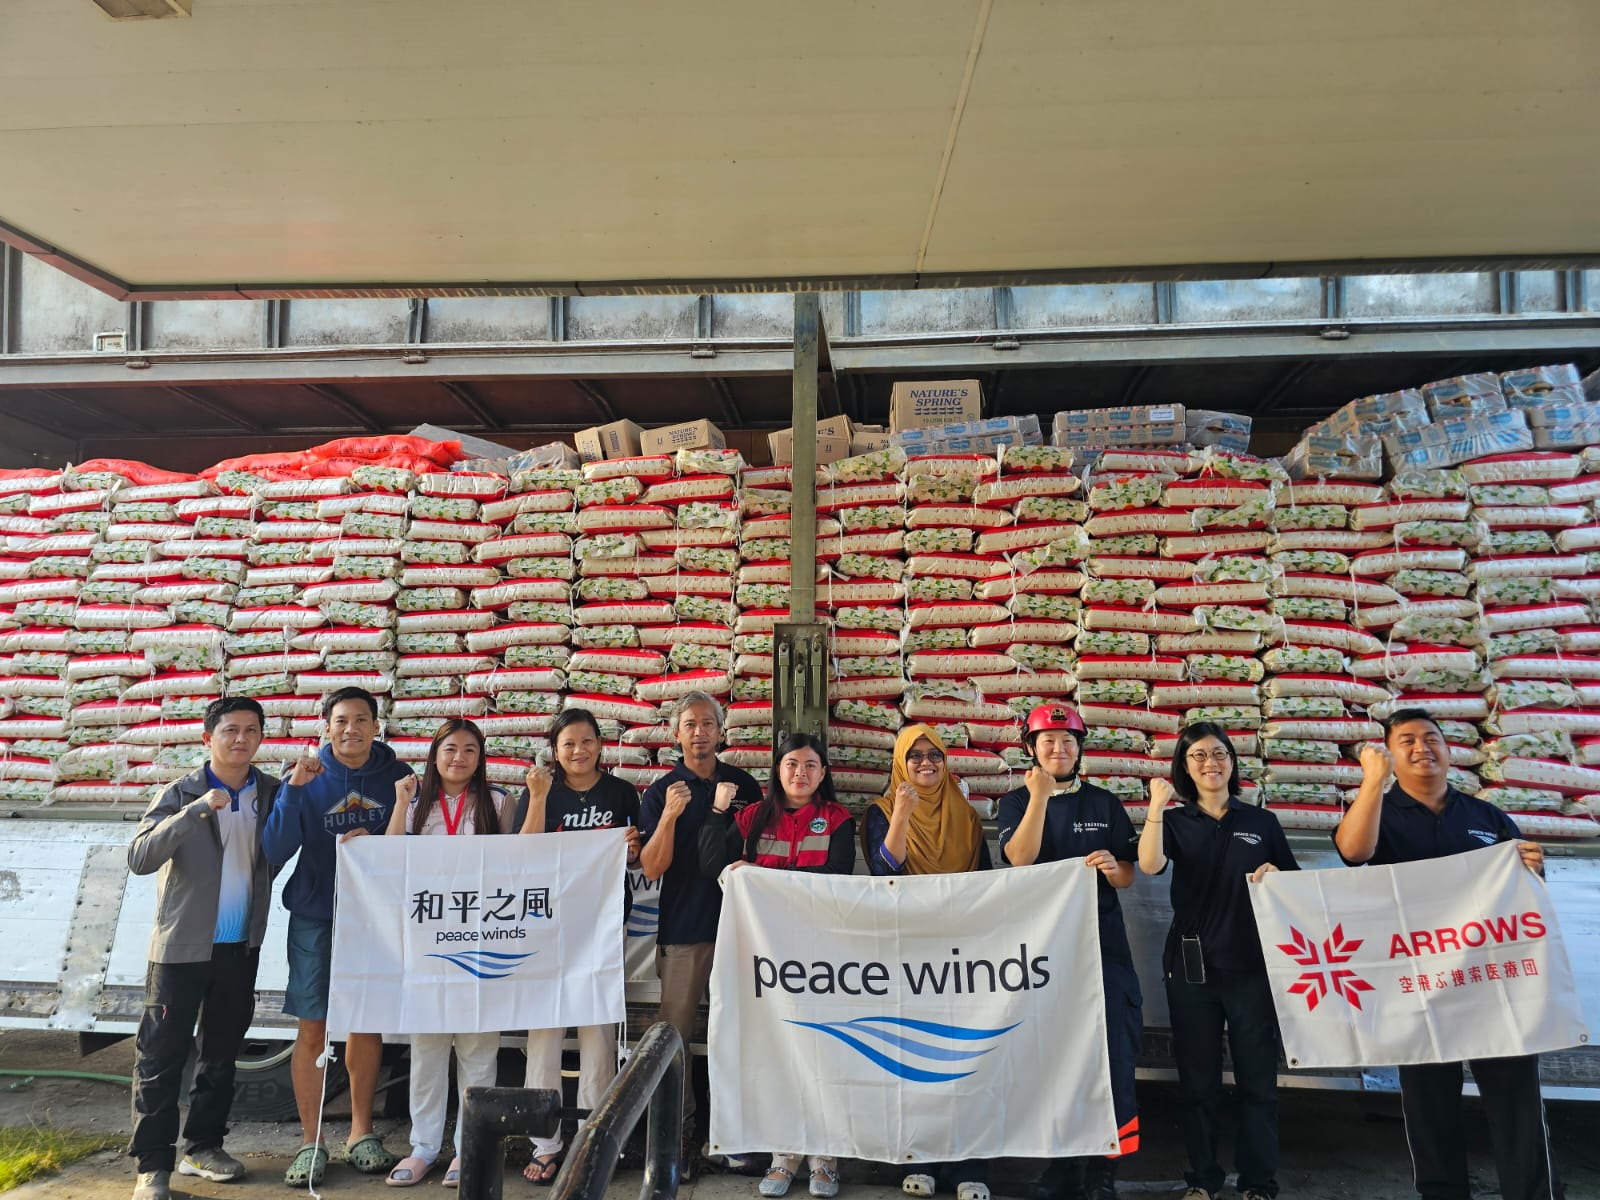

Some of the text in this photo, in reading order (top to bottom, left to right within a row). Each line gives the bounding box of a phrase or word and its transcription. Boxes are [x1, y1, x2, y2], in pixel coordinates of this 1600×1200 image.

[910, 388, 968, 398] NATURE'S
[916, 397, 962, 407] SPRING
[323, 807, 387, 829] HURLEY
[562, 805, 614, 828] nike
[410, 887, 553, 924] 和平之風
[435, 925, 526, 944] peace winds
[1389, 911, 1547, 959] ARROWS
[753, 943, 1050, 998] peace winds
[1398, 958, 1539, 993] 空飛ぶ捜索医療団
